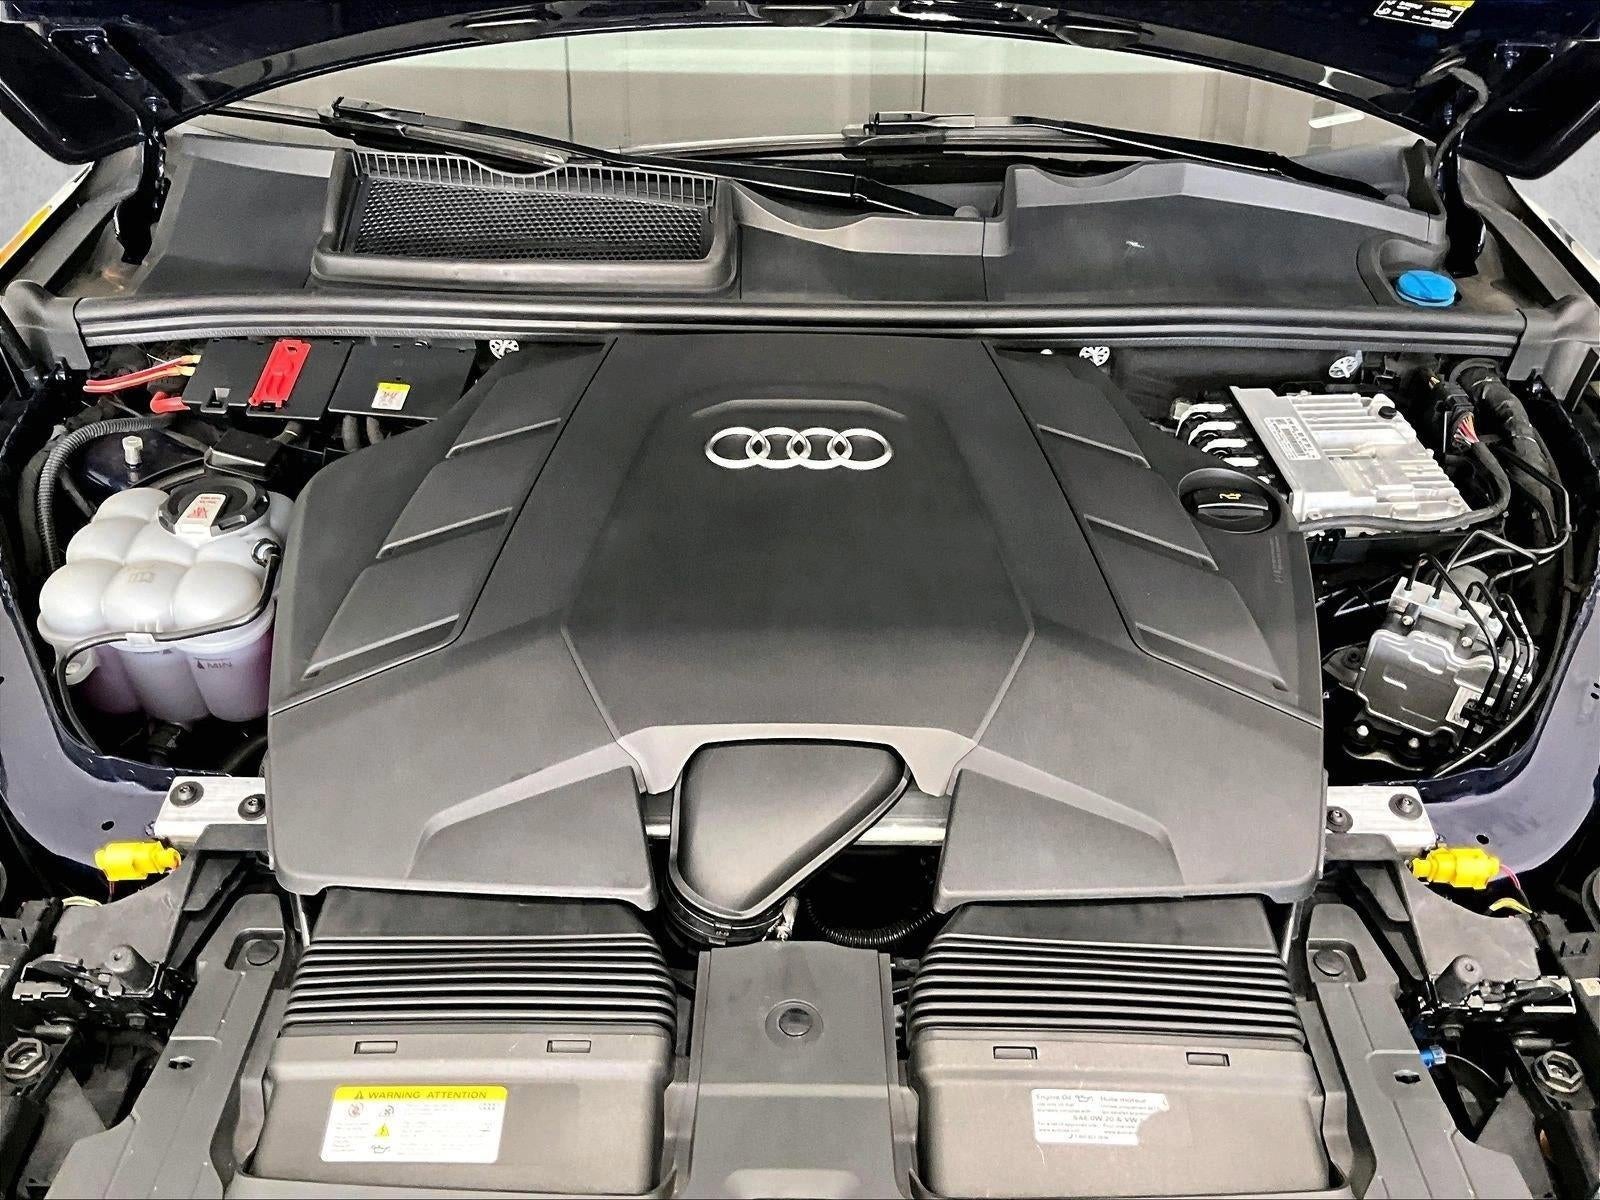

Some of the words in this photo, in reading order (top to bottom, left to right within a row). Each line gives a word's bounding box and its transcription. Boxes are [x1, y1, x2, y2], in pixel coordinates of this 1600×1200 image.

[207, 661, 233, 669] MIN
[368, 1090, 421, 1099] WARNING
[427, 1090, 487, 1099] ATTENTION
